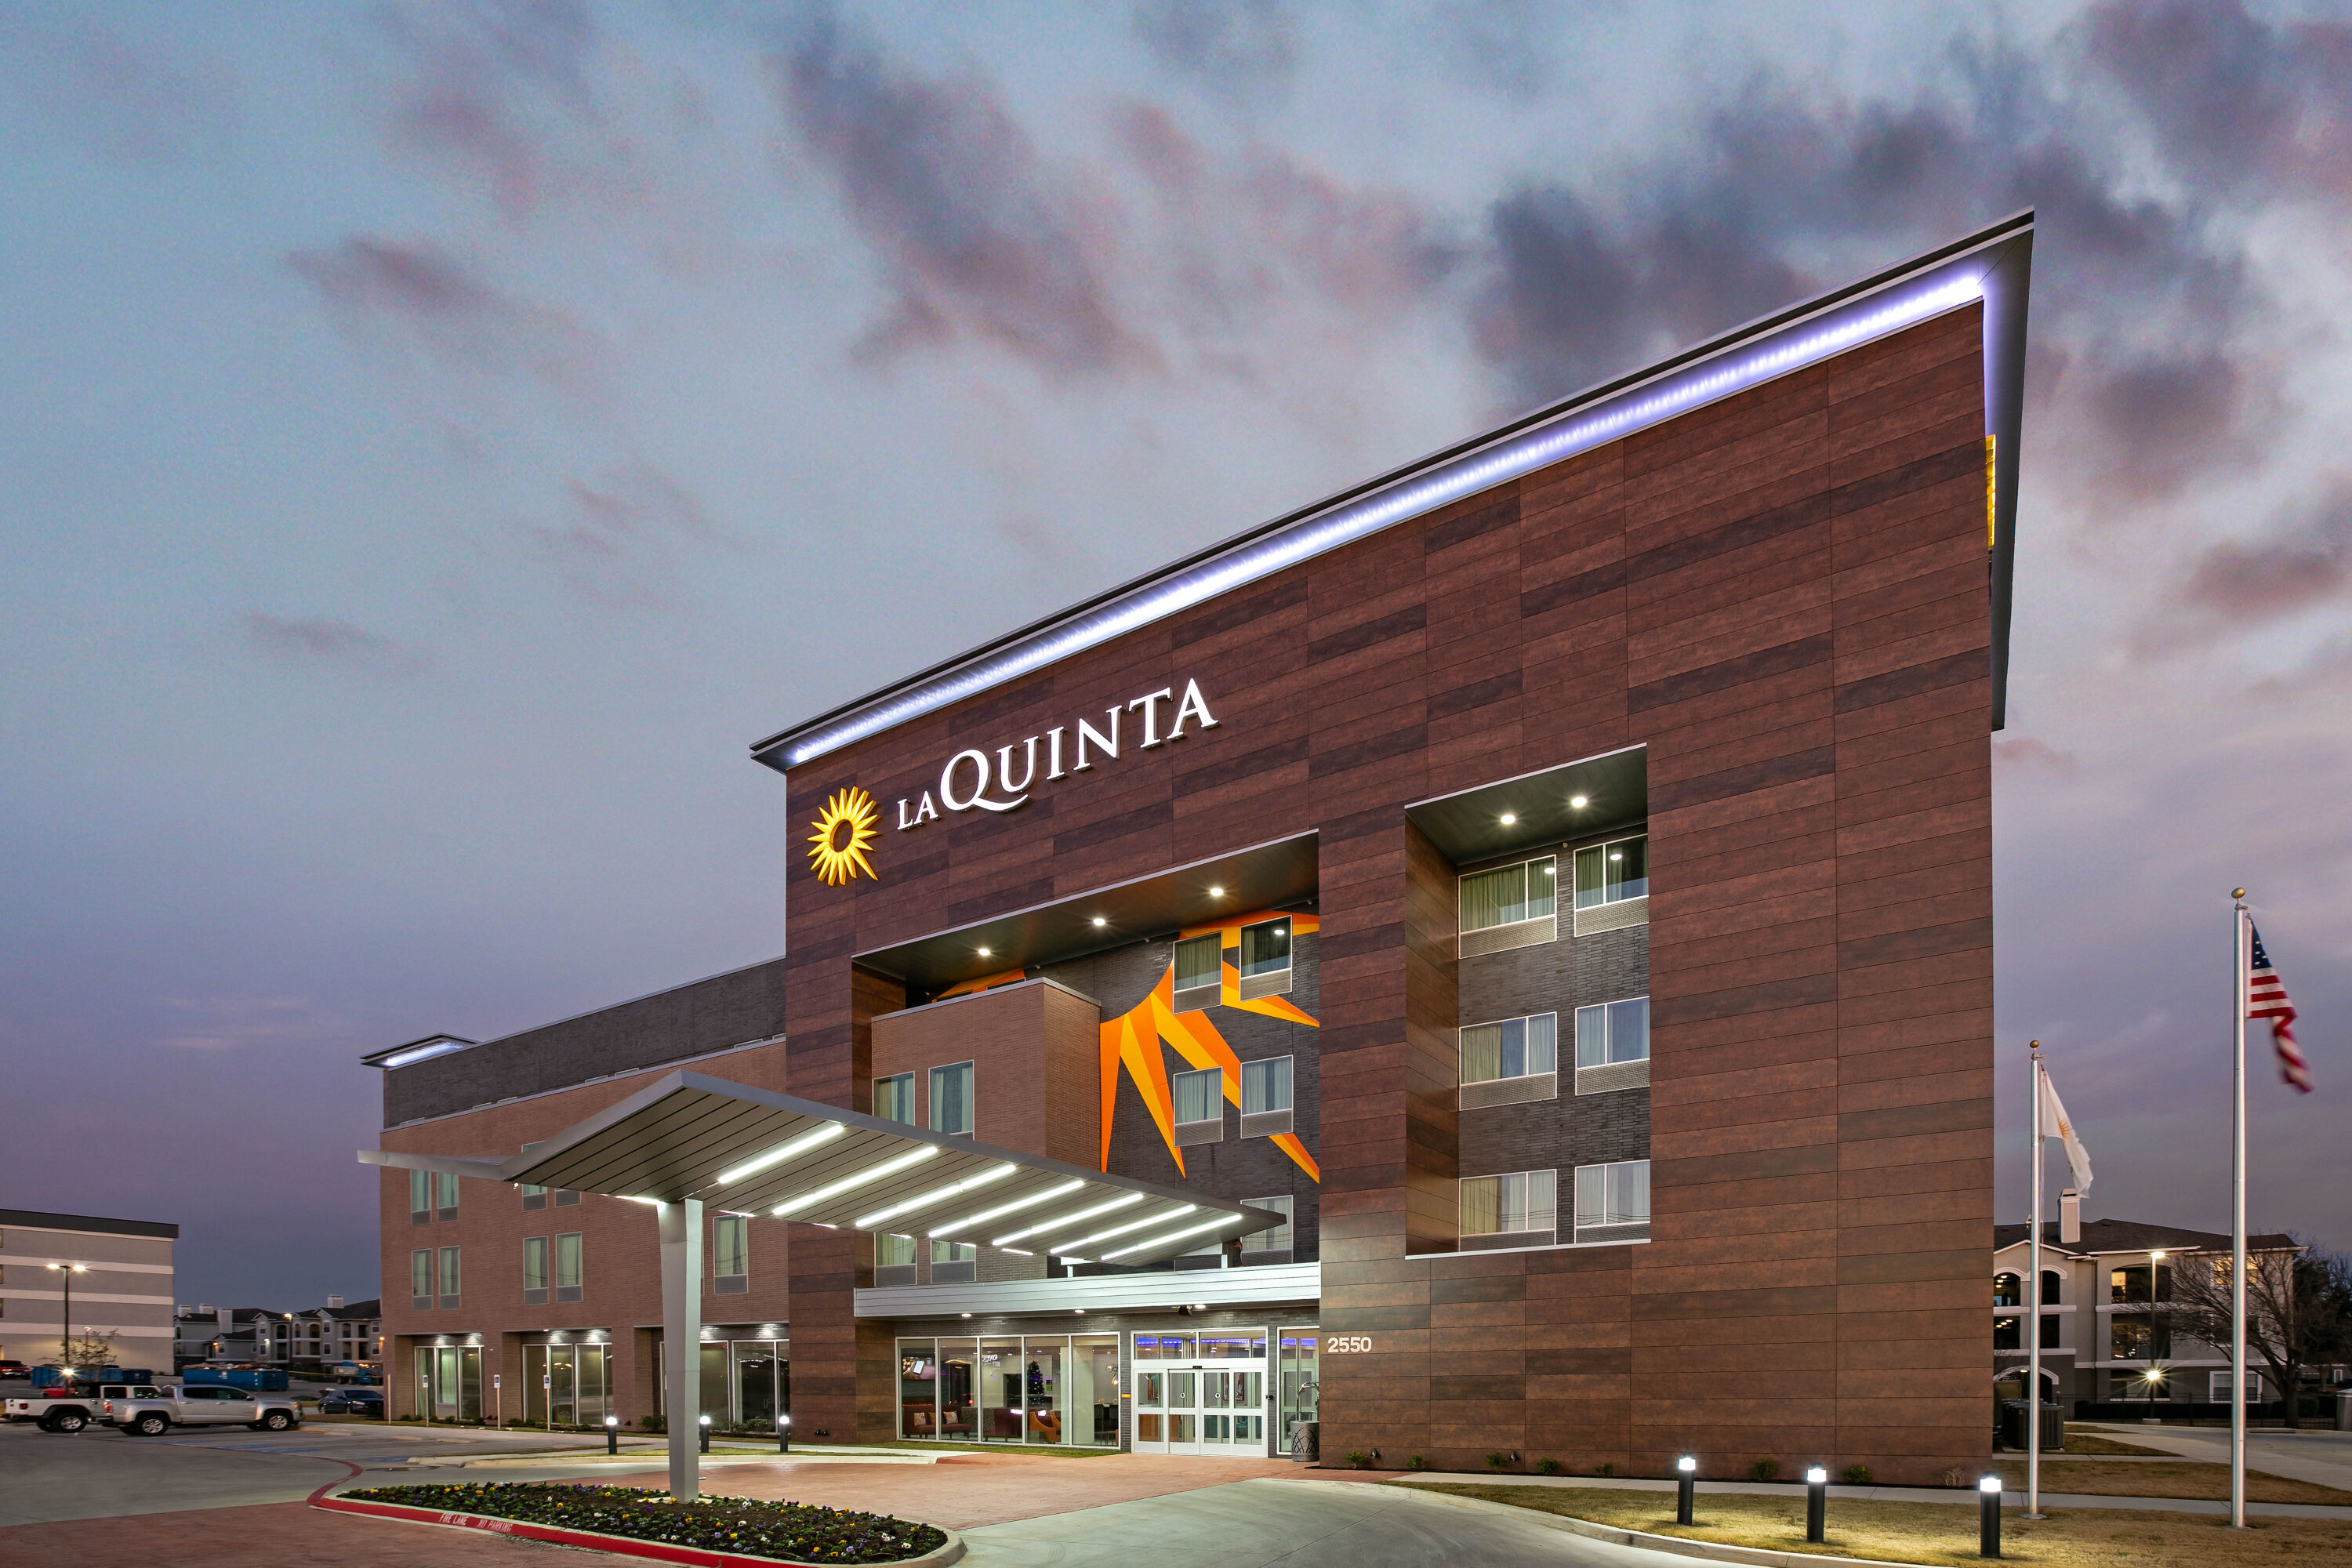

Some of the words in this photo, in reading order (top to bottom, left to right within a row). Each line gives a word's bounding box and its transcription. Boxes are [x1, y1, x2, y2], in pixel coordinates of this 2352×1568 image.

[897, 790, 939, 830] LA
[940, 677, 1220, 813] QUINTA
[1327, 1337, 1372, 1353] 2550
[439, 1513, 453, 1523] FIRE
[452, 1515, 469, 1526] LANE
[477, 1519, 487, 1528] NO
[487, 1521, 513, 1532] PARKING
